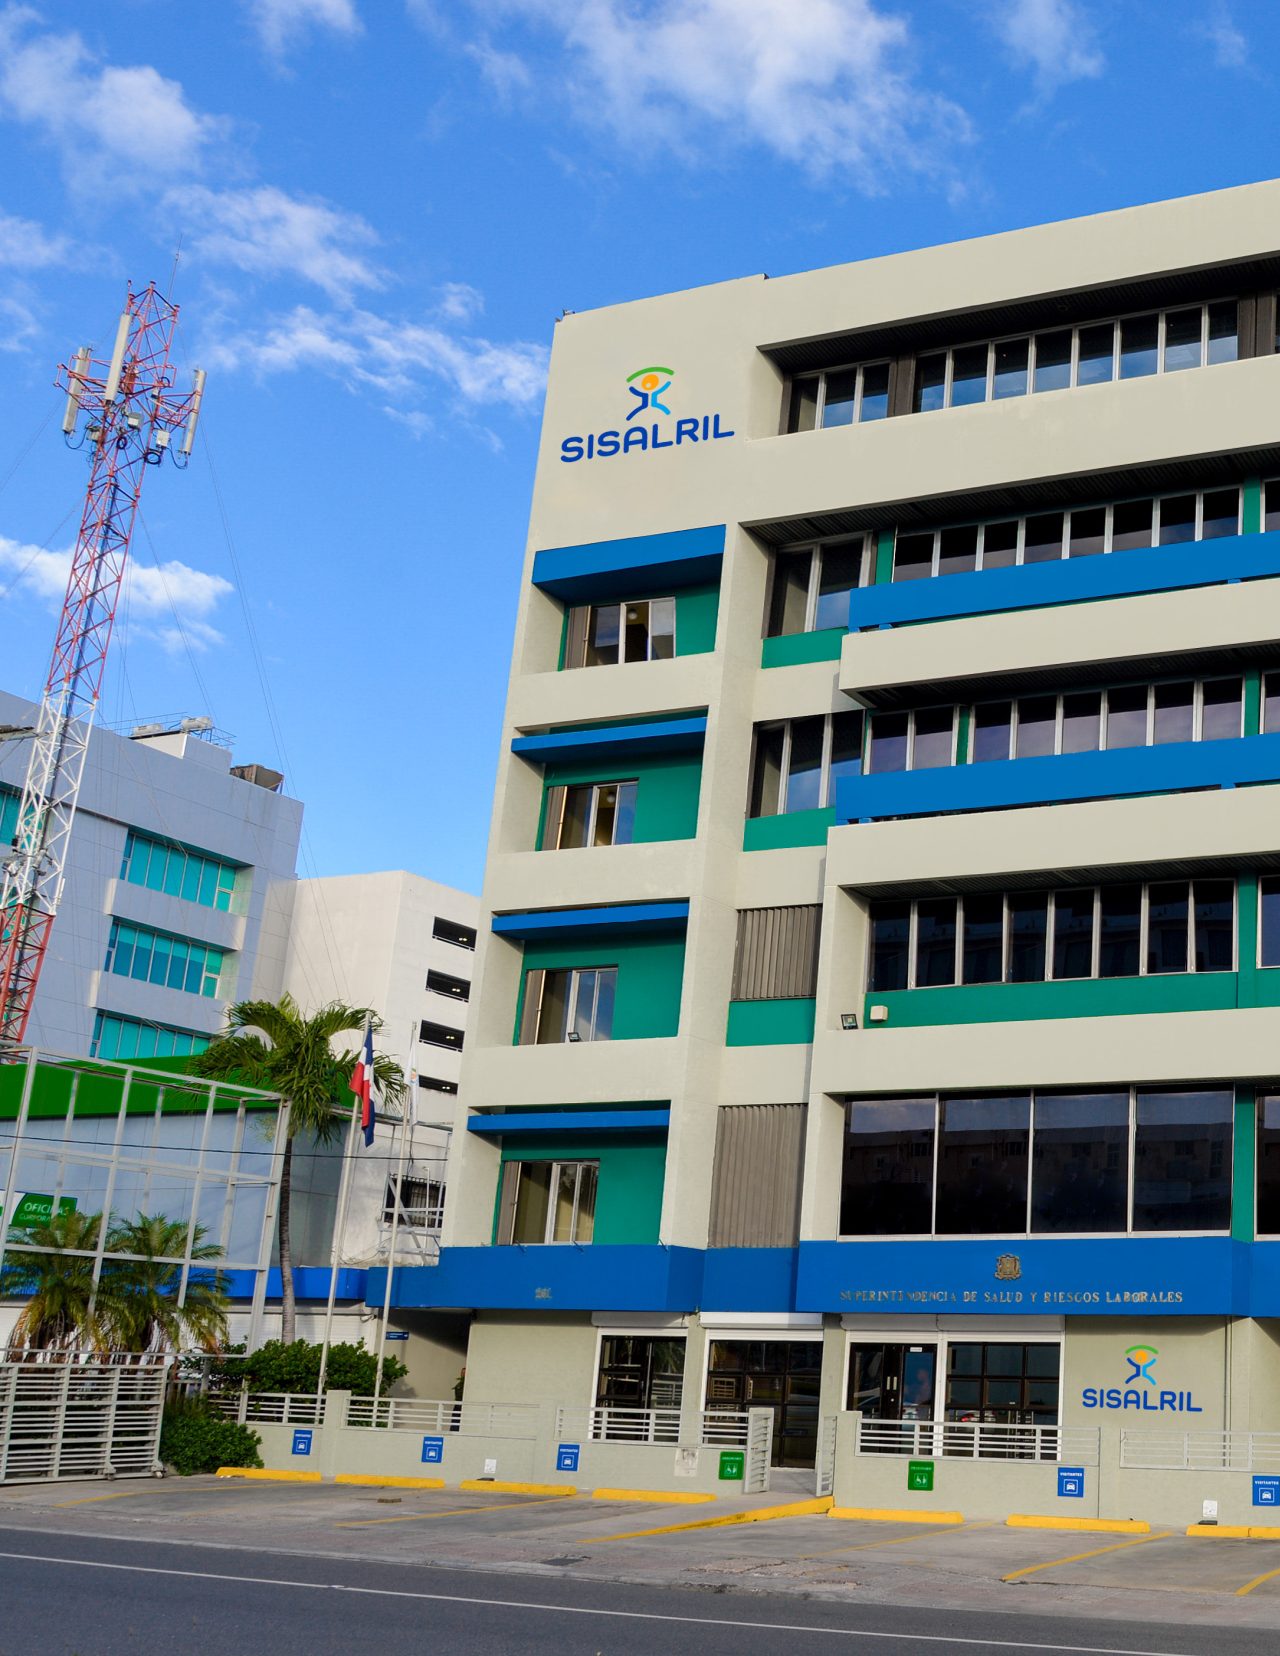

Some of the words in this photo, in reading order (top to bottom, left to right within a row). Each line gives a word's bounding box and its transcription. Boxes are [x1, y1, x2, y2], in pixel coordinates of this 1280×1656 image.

[560, 413, 735, 463] SISALRIL
[840, 1290, 956, 1302] SUPERINTENDENCIA
[963, 1291, 977, 1302] DE
[984, 1291, 1023, 1303] SALUD
[1030, 1292, 1037, 1303] Y
[1106, 1292, 1183, 1303] LABORALES
[1082, 1388, 1203, 1412] SISALRIL
